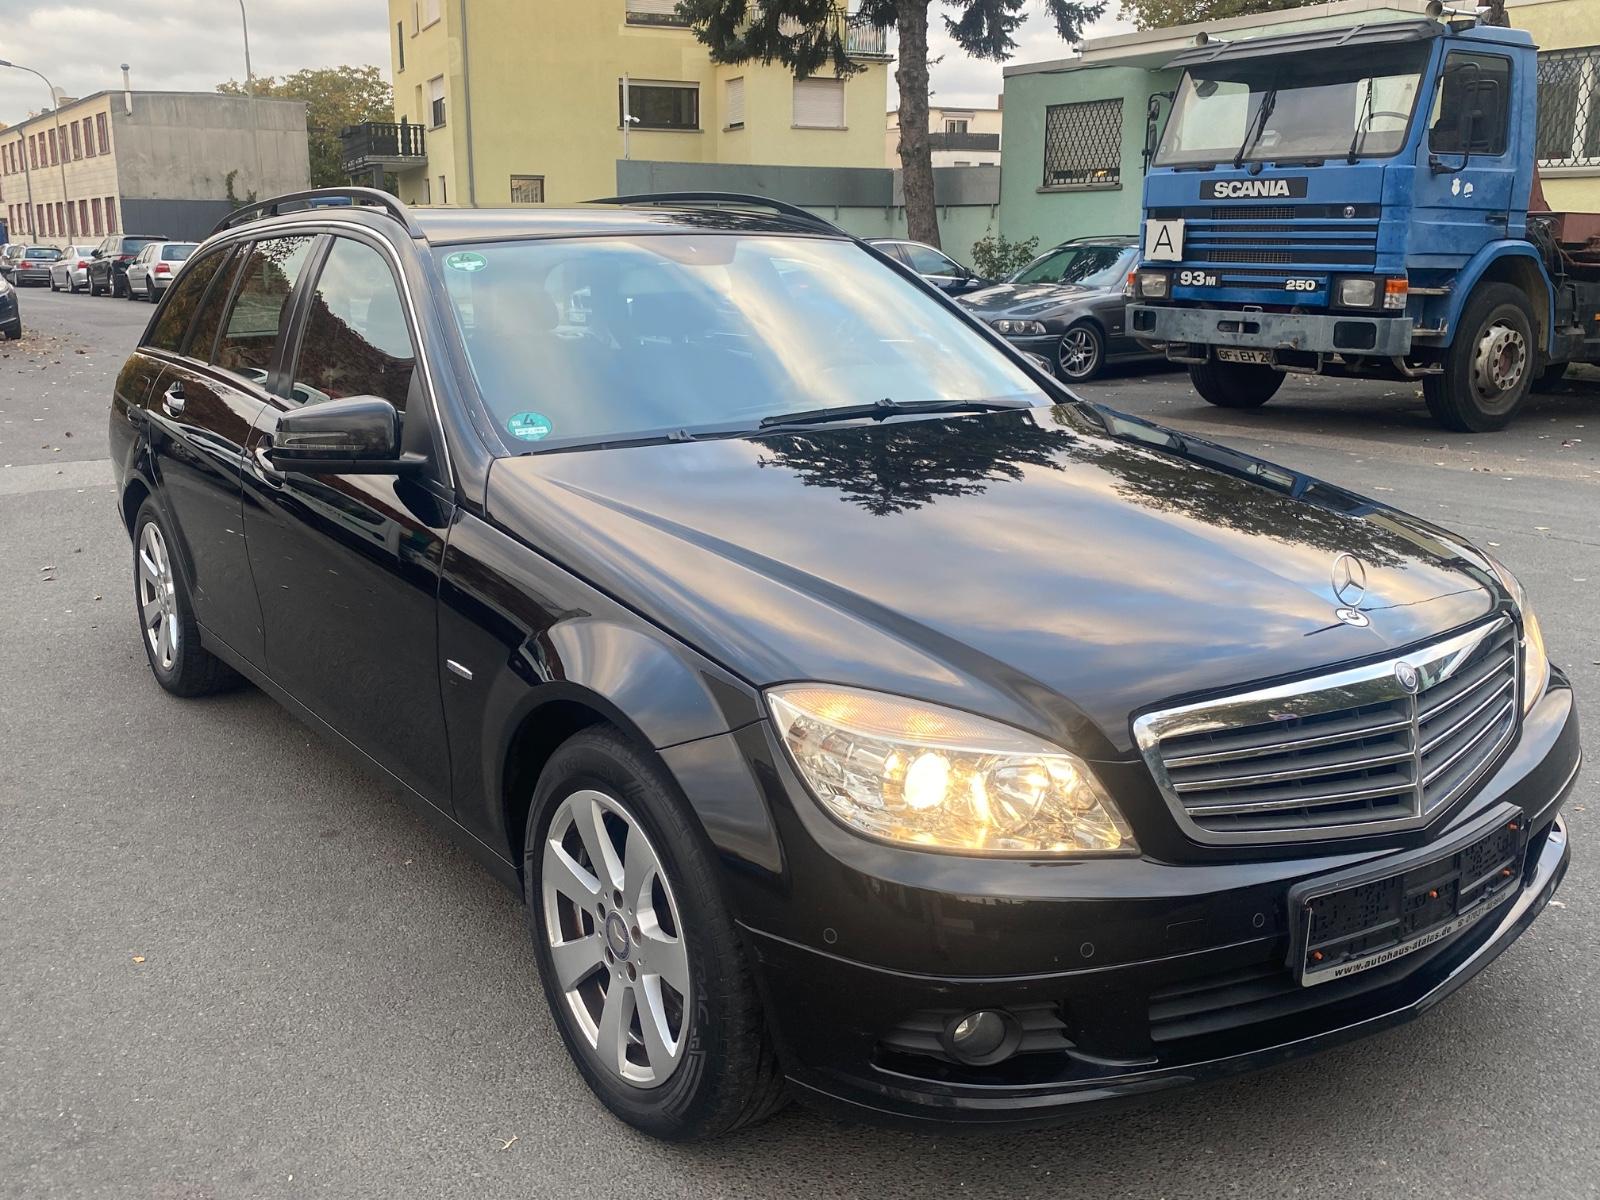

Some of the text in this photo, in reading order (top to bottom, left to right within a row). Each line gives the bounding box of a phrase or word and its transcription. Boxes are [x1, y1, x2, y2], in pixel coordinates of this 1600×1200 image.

[1213, 180, 1290, 198] SCANIA
[1153, 224, 1174, 254] A
[1285, 280, 1316, 291] 250
